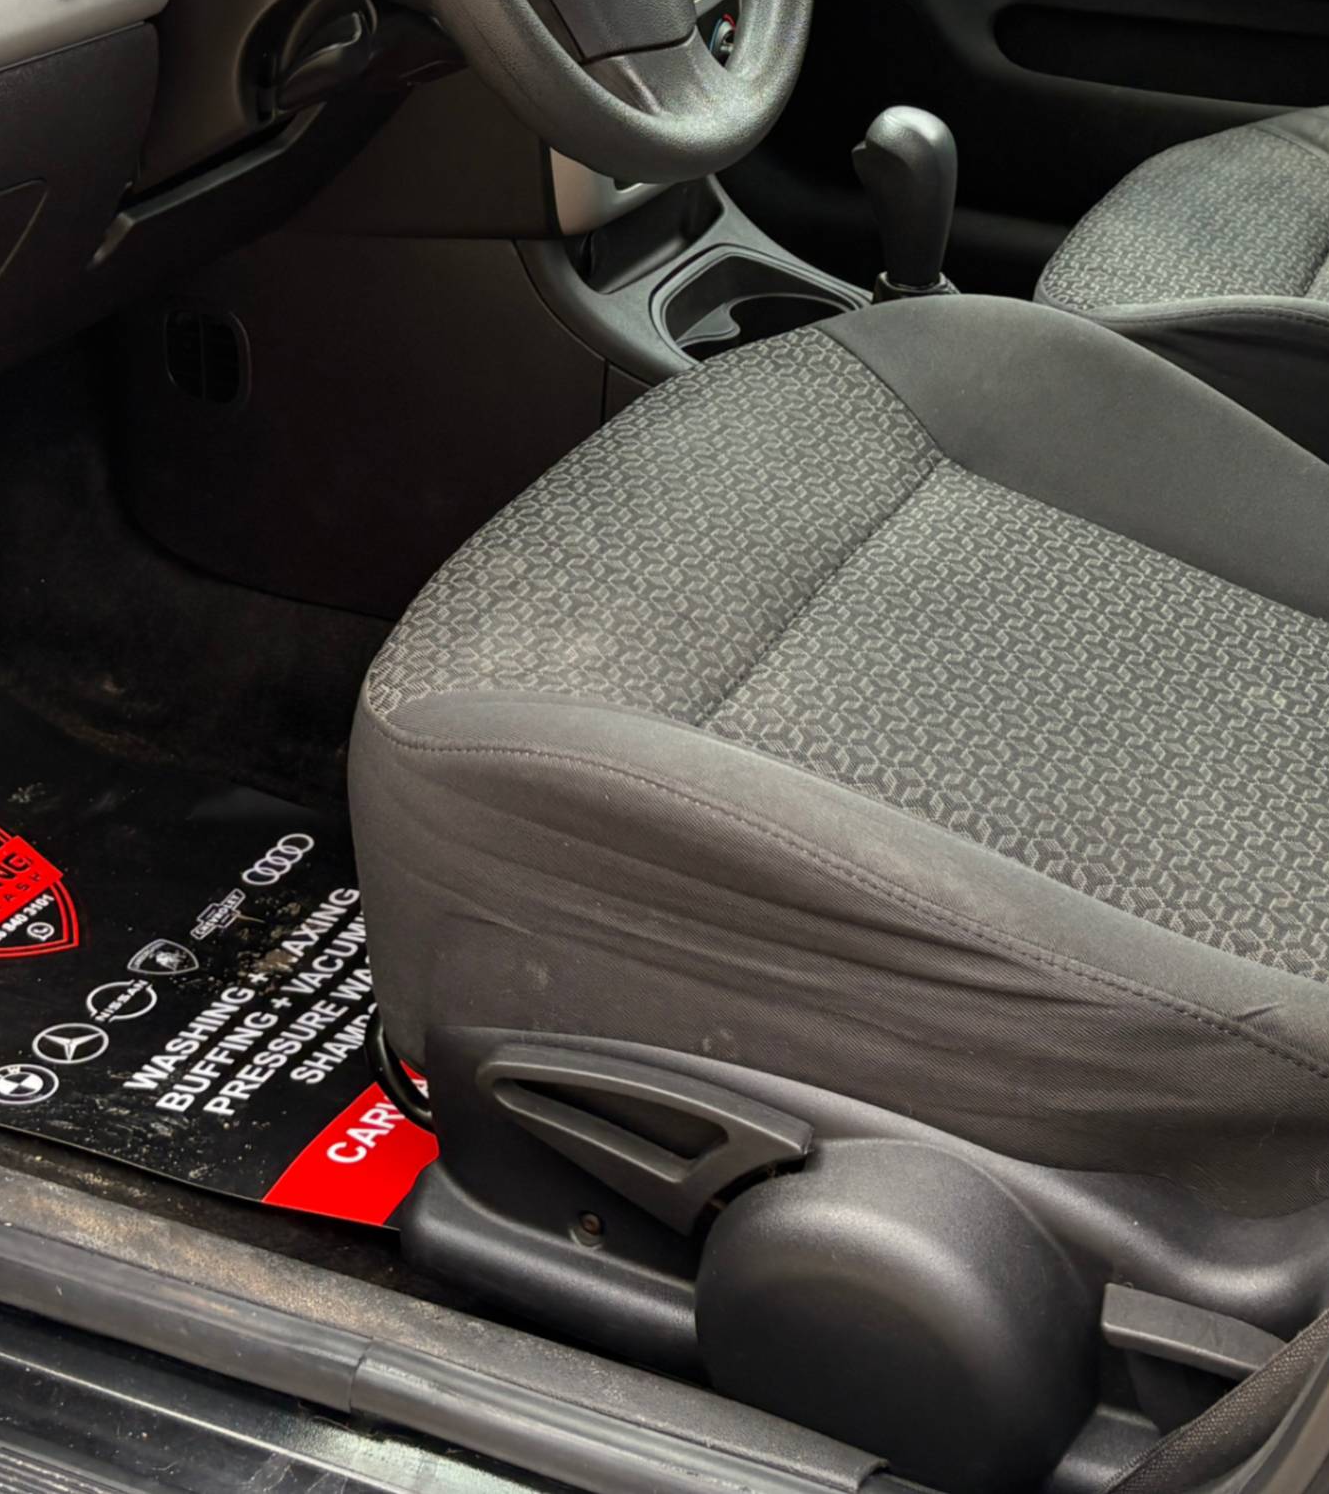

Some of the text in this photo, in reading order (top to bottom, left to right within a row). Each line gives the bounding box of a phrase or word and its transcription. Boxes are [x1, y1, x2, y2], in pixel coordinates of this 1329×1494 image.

[95, 979, 149, 1022] NISSAN
[123, 986, 255, 1089] WASHING
[273, 888, 360, 966] AXING
[155, 1011, 279, 1112] BUFFING
[281, 911, 367, 995] VACUM
[203, 955, 373, 1116] PRESSURE WA
[290, 1002, 378, 1084] SHAMP
